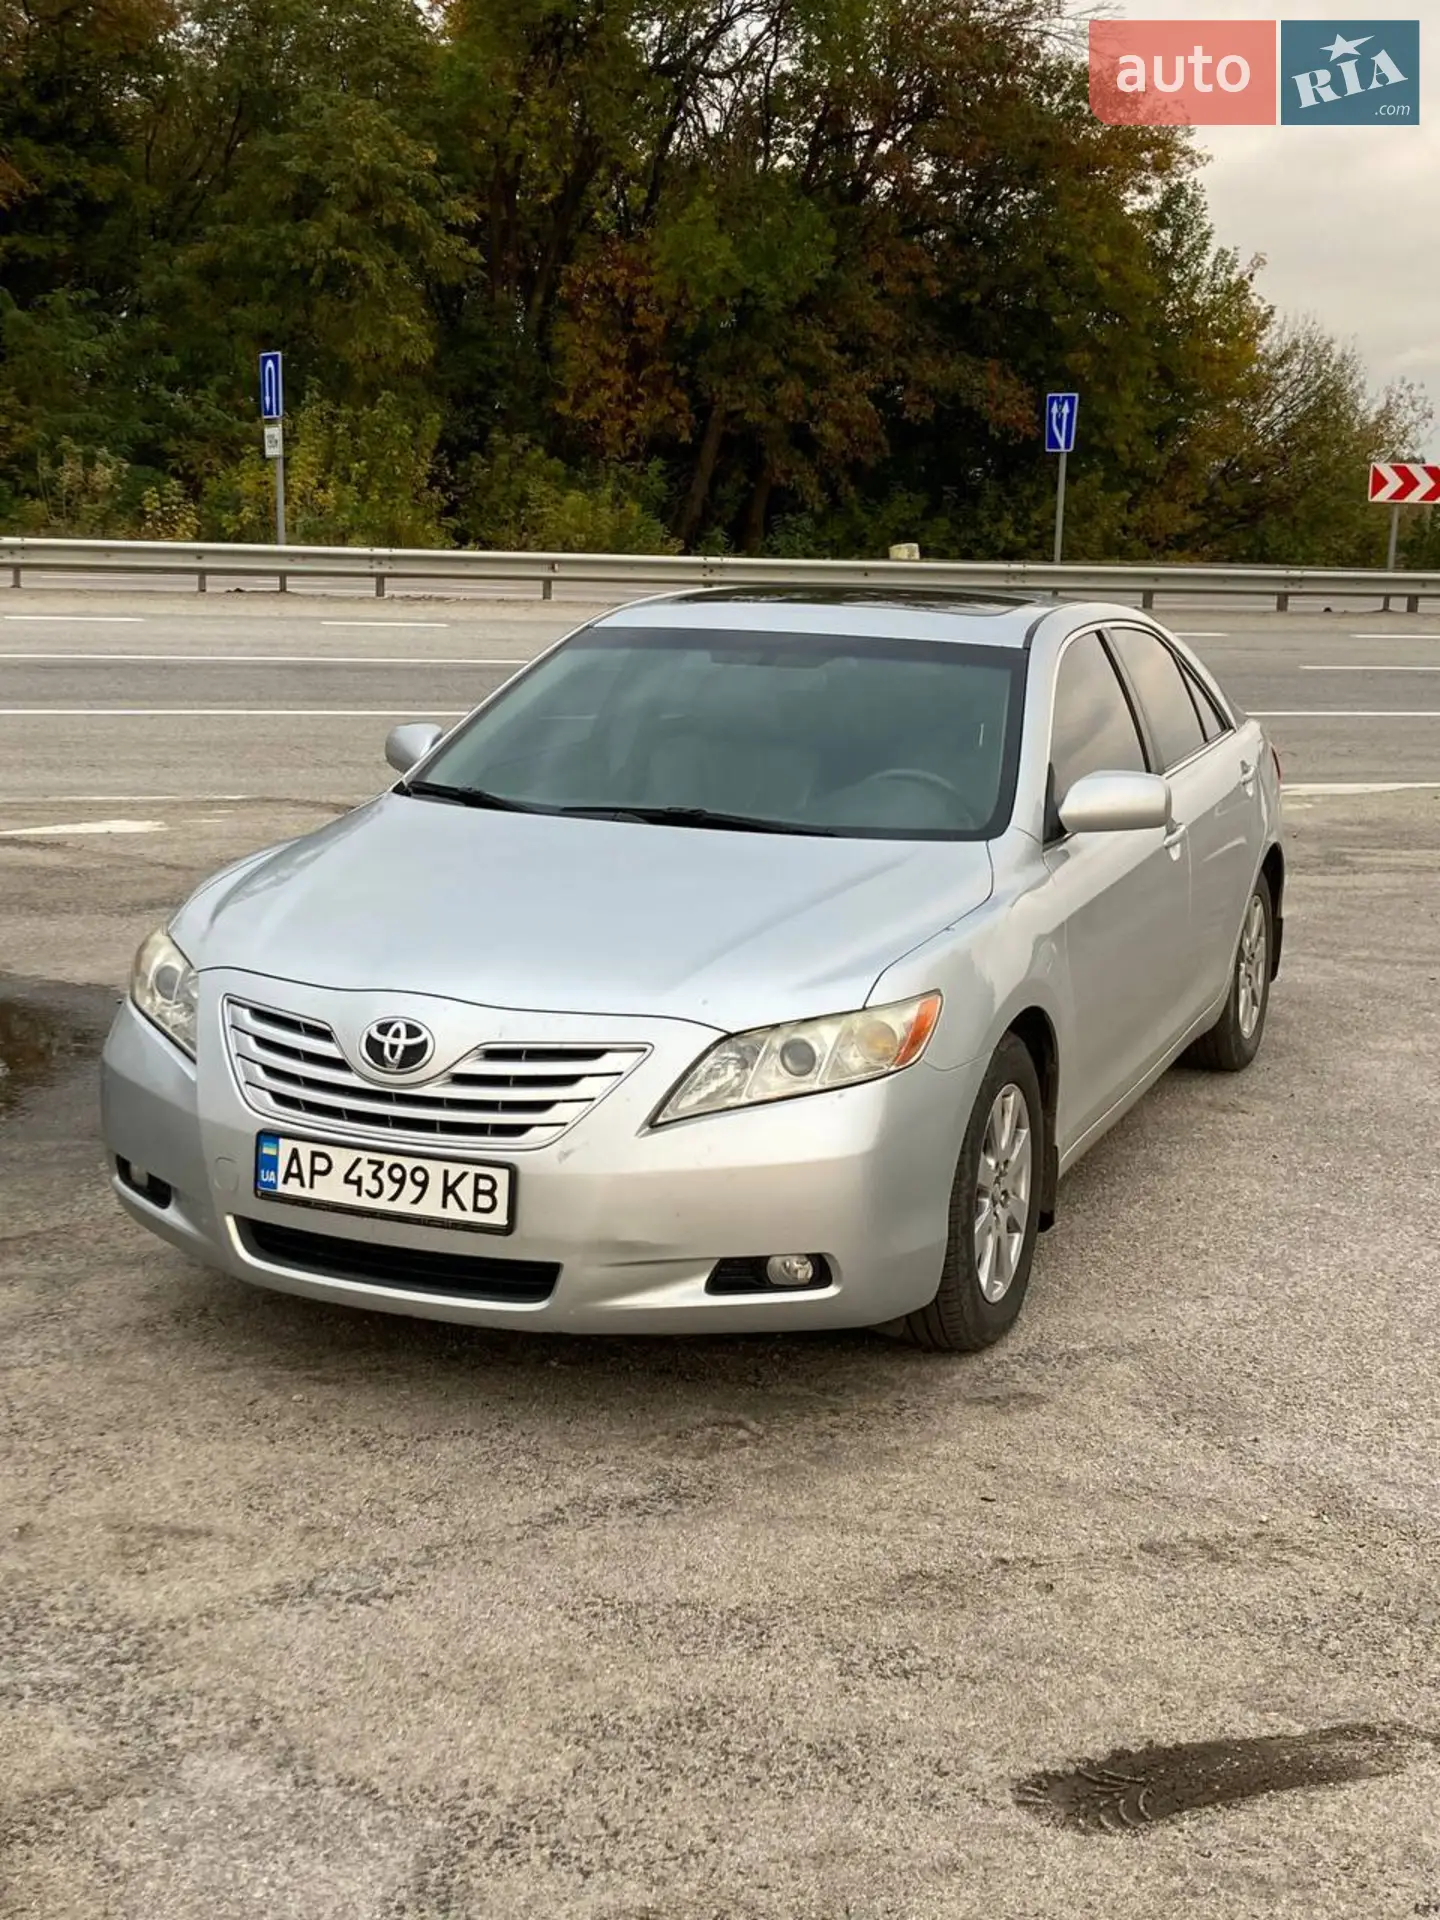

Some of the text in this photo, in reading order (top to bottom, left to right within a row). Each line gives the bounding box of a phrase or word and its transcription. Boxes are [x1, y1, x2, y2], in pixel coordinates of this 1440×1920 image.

[260, 1169, 276, 1184] UA
[282, 1147, 498, 1214] AP 4399 KB
